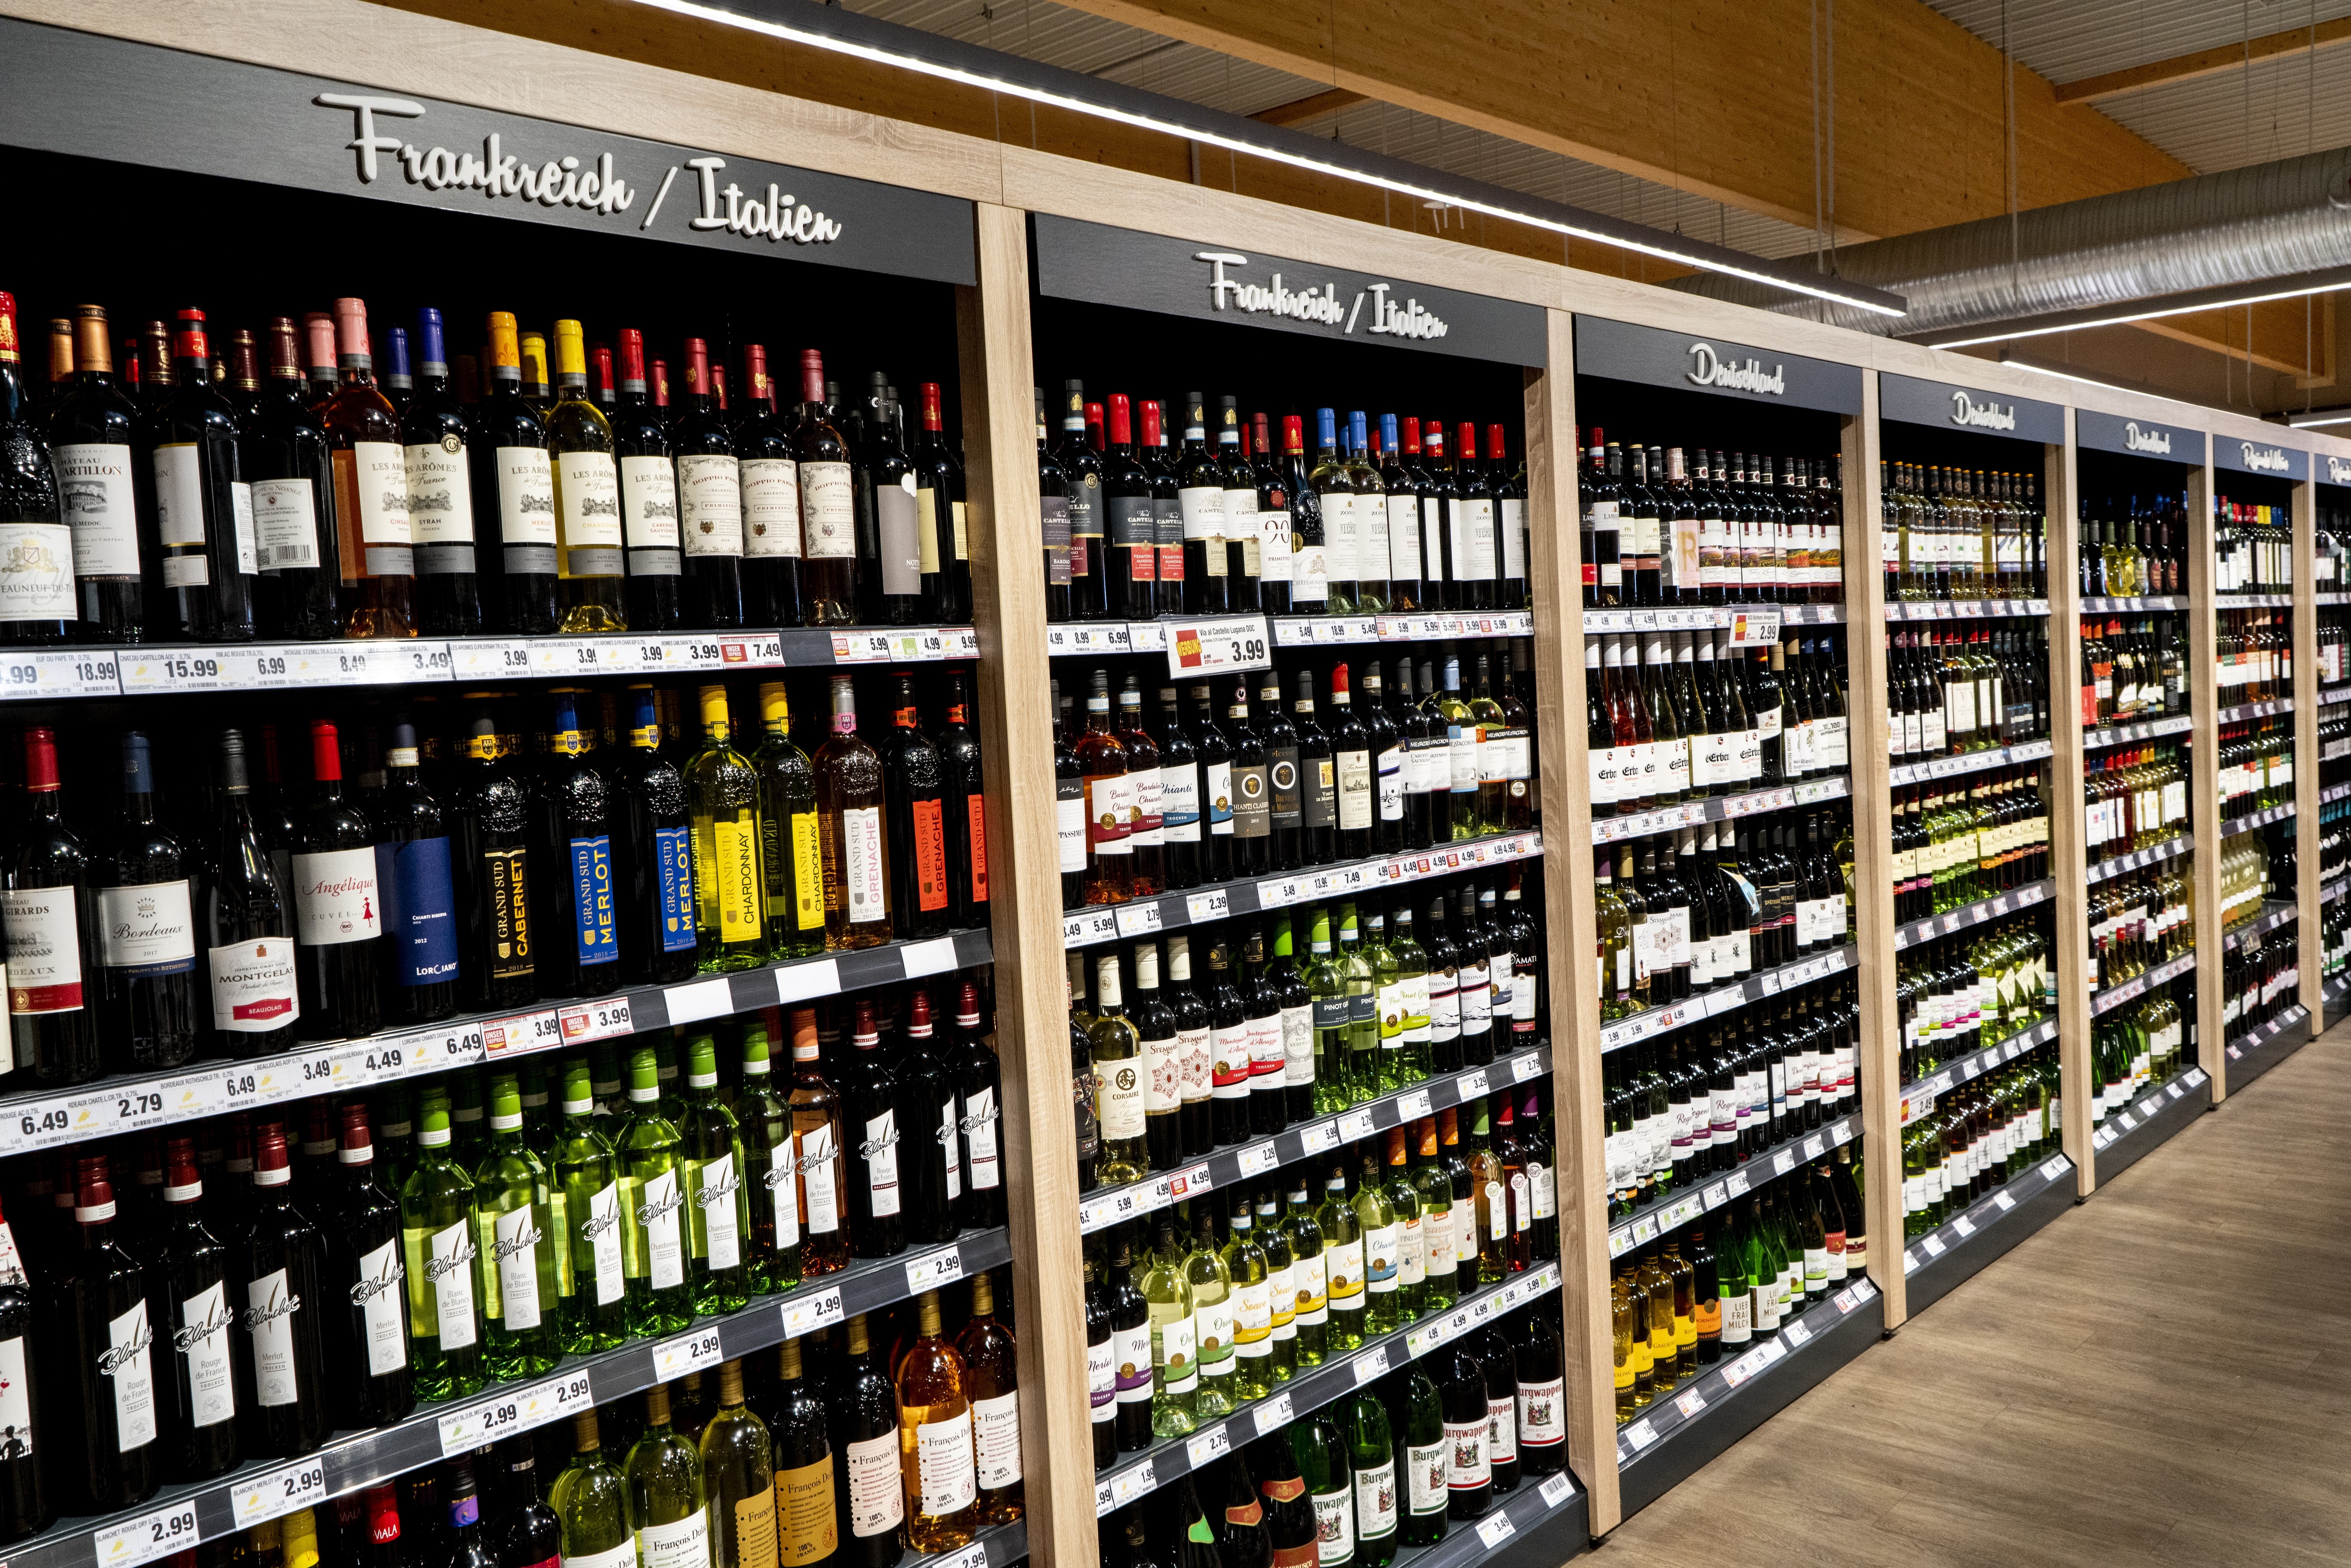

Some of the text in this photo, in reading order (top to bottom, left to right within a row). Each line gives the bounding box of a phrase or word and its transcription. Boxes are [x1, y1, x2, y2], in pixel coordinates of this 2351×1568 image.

[315, 92, 634, 213] Frankreich
[685, 157, 842, 243] Italien
[1195, 252, 1344, 325] Frankreich
[1367, 283, 1448, 339] Italien
[1688, 343, 1785, 395] Deutschland
[1951, 391, 2015, 431] Deutschland
[416, 462, 457, 472] ARÔMES
[418, 476, 447, 485] France
[745, 479, 774, 489] DOPPIO
[1265, 520, 1290, 544] 90
[1213, 627, 1230, 635] Castello
[1230, 626, 1246, 635] Lugana
[1362, 623, 1376, 634] 5.49
[1760, 625, 1776, 640] 2.99
[1108, 632, 1128, 643] 6.99
[691, 645, 719, 659] 3.99
[753, 644, 781, 657] 7.49
[1176, 638, 1202, 657] WERBUNG
[1232, 639, 1264, 662] 3.99
[413, 653, 448, 669] 3.49
[505, 651, 527, 666] 3.99
[76, 662, 116, 681] 18.99
[165, 659, 218, 678] 15.99
[258, 658, 285, 675] 6.99
[866, 819, 880, 904] GRENACHE
[738, 832, 754, 924] CHARDONNAY
[1345, 872, 1360, 883] 7.49
[302, 876, 374, 896] Angélique
[579, 851, 593, 926] GRAND SUD
[494, 861, 508, 938] GRAND SUD
[593, 849, 613, 944] MERLOT
[1209, 897, 1227, 910] 2.39
[511, 860, 528, 956] CABERNET
[852, 906, 884, 915] LIEBLICH
[311, 911, 351, 921] CUVÉE
[113, 923, 183, 940] Bordeaux
[219, 967, 294, 983] MONTGELAS
[249, 1004, 282, 1014] BEAUJOLAIS
[599, 1008, 630, 1026] 3.99
[485, 1030, 504, 1039] UNSER
[535, 1019, 558, 1037] 3.99
[1631, 1025, 1641, 1035] 3.99
[447, 1034, 481, 1055] 6.49
[366, 1049, 402, 1070] 4.49
[1528, 1058, 1540, 1070] 2.79
[304, 1060, 330, 1080] 3.49
[161, 1080, 184, 1089] BORDEAUX
[186, 1074, 212, 1085] ROTHSCHILD
[1112, 1091, 1139, 1100] CORSAIRE
[118, 1093, 163, 1117] 2.79
[21, 1110, 69, 1135] 6.49
[795, 1145, 838, 1175] Blanchet
[1263, 1147, 1275, 1161] 2.29
[1192, 1170, 1209, 1186] 4.99
[1715, 1187, 1725, 1198] 2.49
[650, 1238, 679, 1251] Chardonnay
[424, 1243, 475, 1282] Blanchet
[514, 1278, 533, 1288] Blancs
[814, 1296, 841, 1316] 2.99
[1239, 1300, 1267, 1312] Soave
[1735, 1301, 1748, 1311] LIEB
[1732, 1311, 1748, 1320] FRAU
[174, 1305, 234, 1352] Blanchet
[1728, 1318, 1749, 1329] MILCH
[200, 1356, 222, 1370] Rouge
[262, 1352, 283, 1361] Merlot
[1280, 1399, 1292, 1414] 1.79
[483, 1404, 517, 1429] 2.99
[445, 1433, 473, 1446] halbtrocken
[929, 1434, 960, 1447] François
[937, 1497, 955, 1508] FRANCE
[938, 1492, 952, 1503] 100%
[96, 1529, 120, 1543] BLANCHET
[121, 1523, 137, 1534] ROUGE
[148, 1516, 161, 1524] 0,75L
[151, 1512, 194, 1543] 2.99
[374, 1526, 397, 1539] VIALA
[1494, 1518, 1510, 1533] 3.49
[654, 1535, 690, 1551] François
